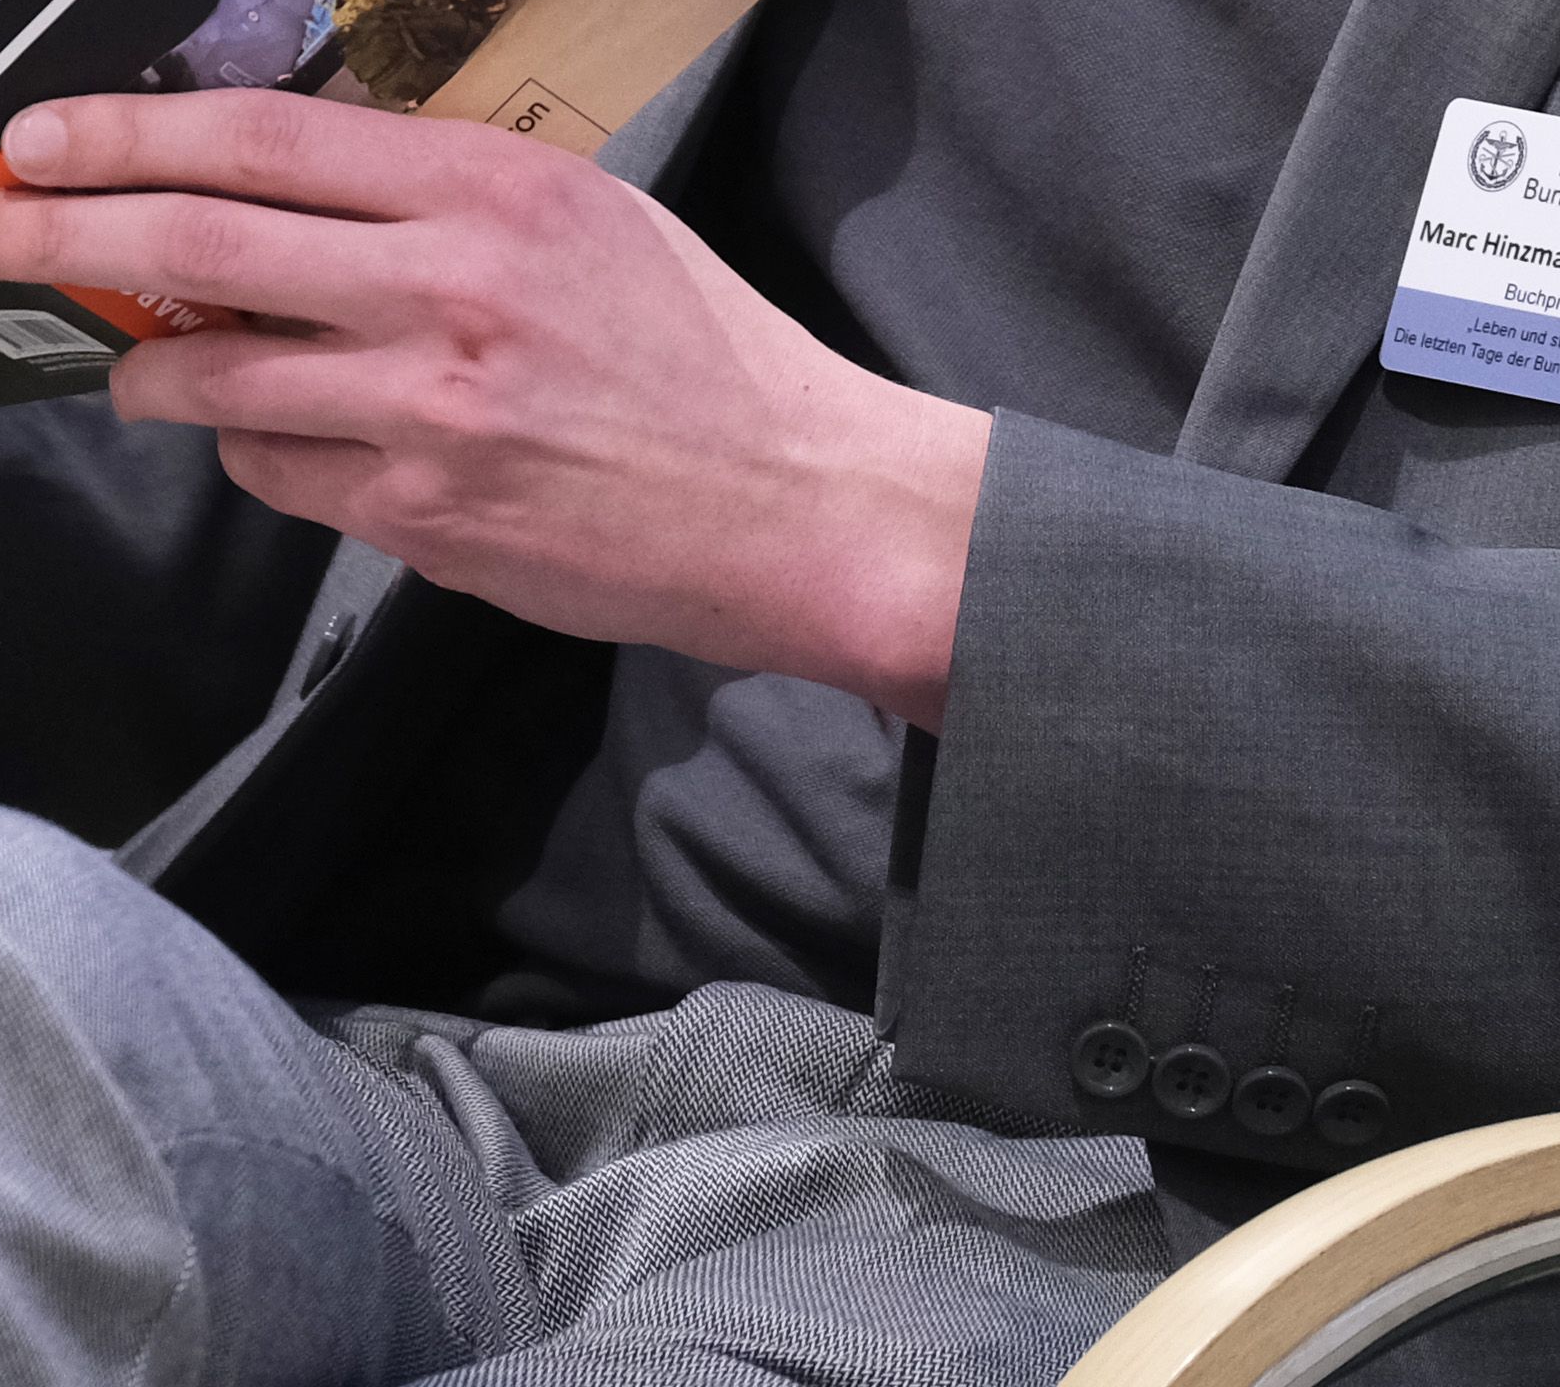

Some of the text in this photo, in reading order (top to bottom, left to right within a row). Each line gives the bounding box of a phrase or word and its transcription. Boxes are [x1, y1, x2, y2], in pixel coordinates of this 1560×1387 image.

[1419, 219, 1478, 253] Marc
[117, 289, 206, 333] MAR
[1393, 327, 1417, 346] Die
[1420, 333, 1467, 357] letzten
[1470, 342, 1504, 366] Tage
[1507, 348, 1531, 368] der
[1520, 327, 1546, 346] und
